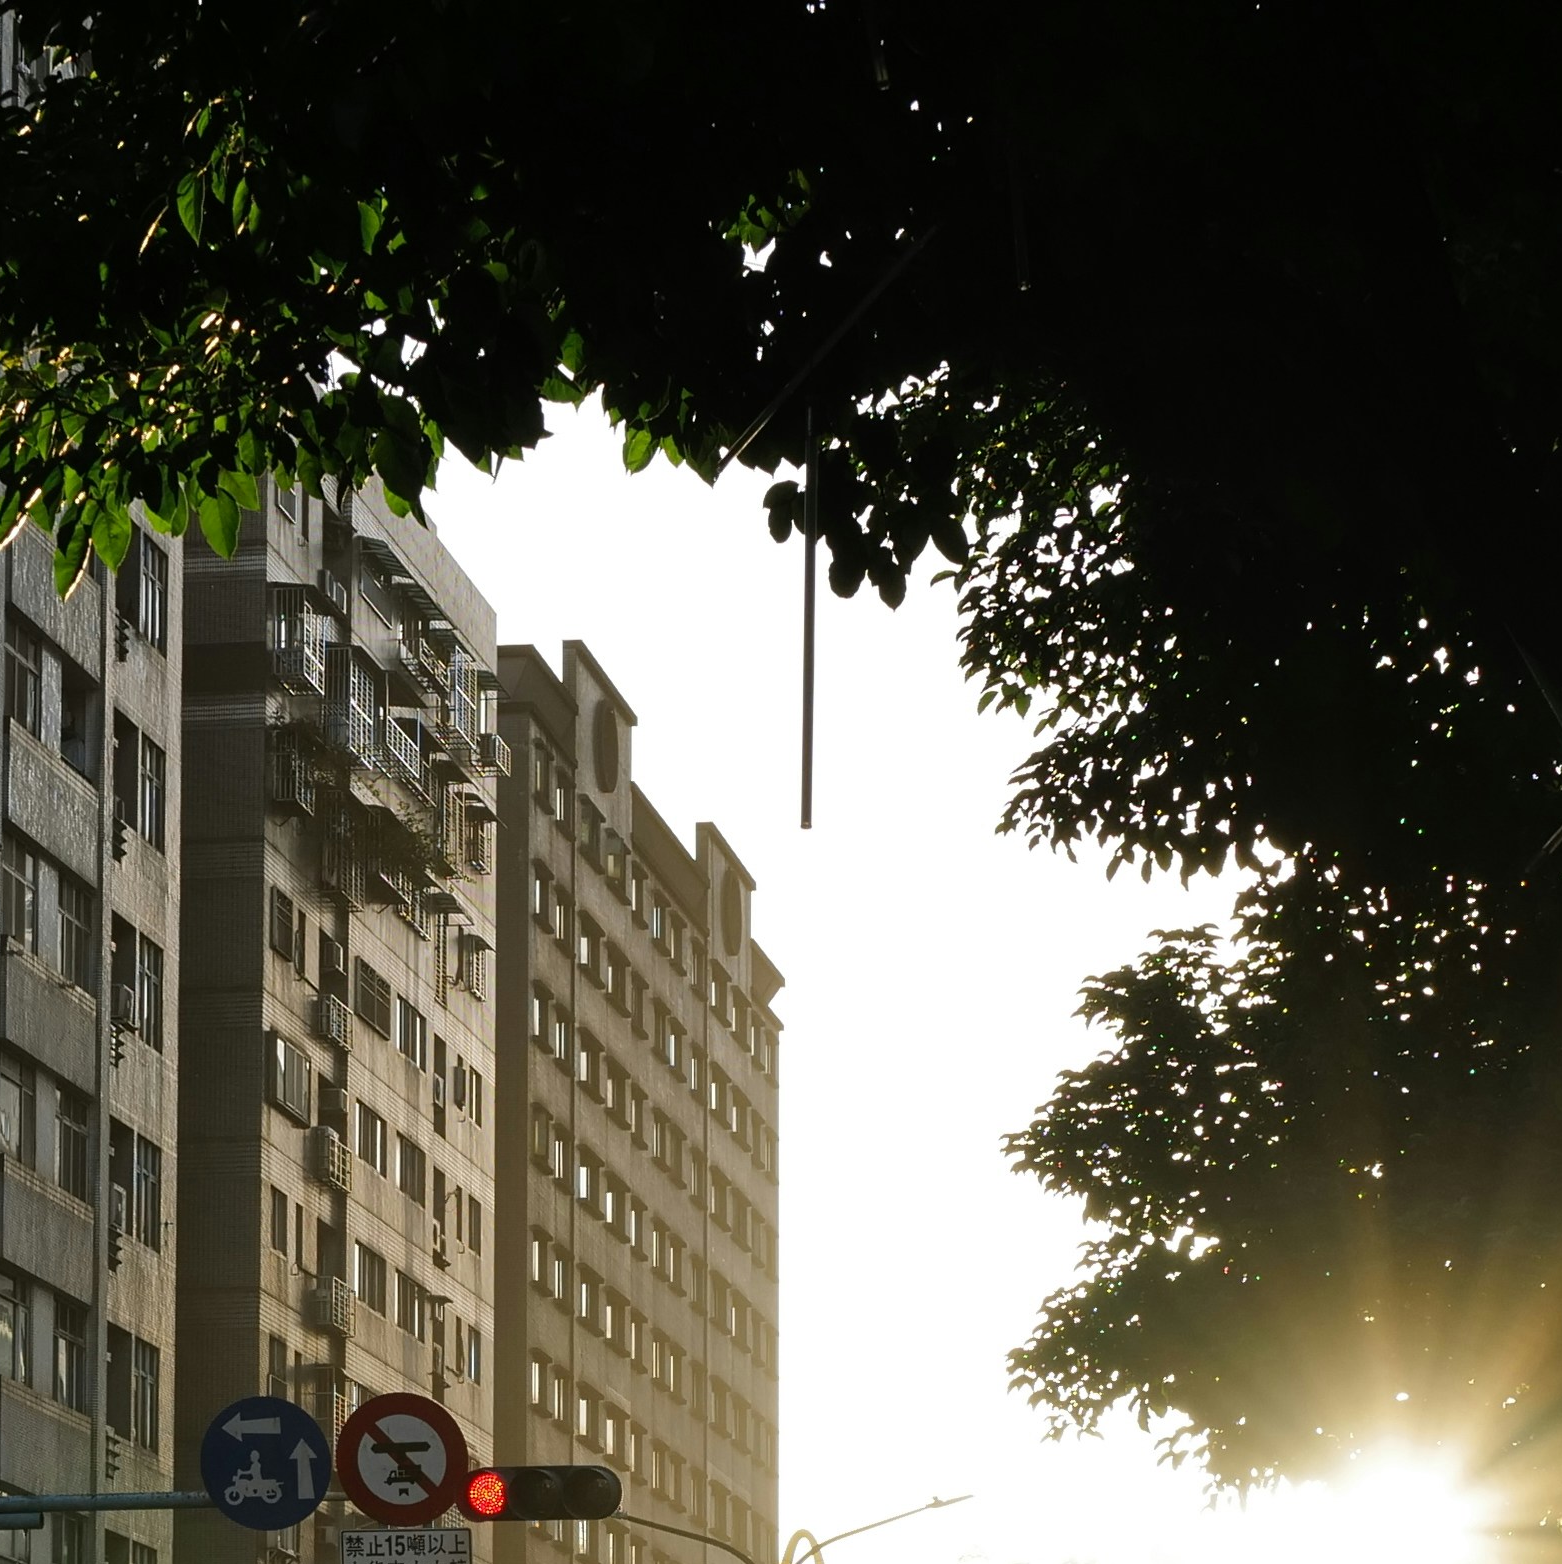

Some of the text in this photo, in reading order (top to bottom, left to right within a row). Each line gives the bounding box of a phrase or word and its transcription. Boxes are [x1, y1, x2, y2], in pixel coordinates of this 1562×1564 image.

[345, 1535, 467, 1557] 禁止15噸以上
